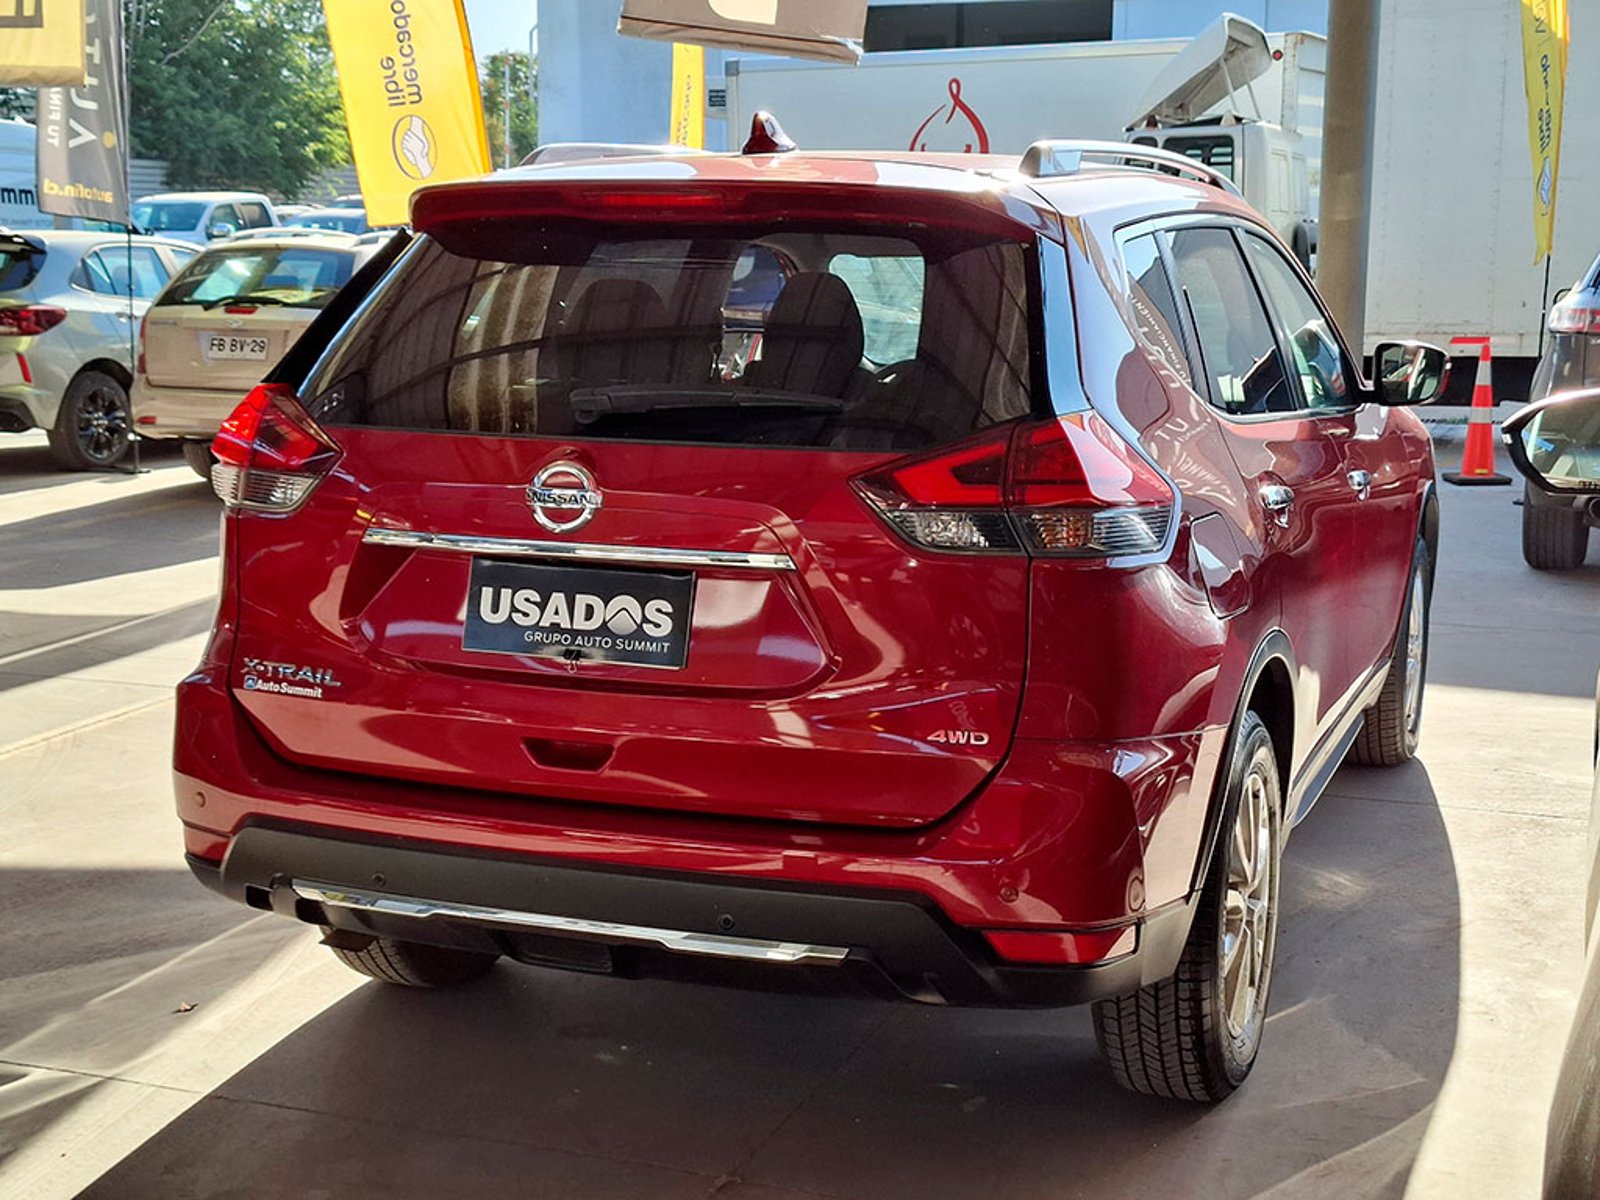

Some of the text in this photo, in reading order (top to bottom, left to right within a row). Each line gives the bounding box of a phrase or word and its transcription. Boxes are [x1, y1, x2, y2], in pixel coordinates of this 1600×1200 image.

[209, 337, 225, 352] FB
[531, 490, 592, 506] NISSAN
[479, 586, 674, 638] USADOS
[523, 630, 671, 654] GRUPO AUTO SUMMIT
[241, 657, 341, 687] X-TRAIL
[256, 679, 323, 698] Auto Summit
[926, 729, 990, 746] 4WD
